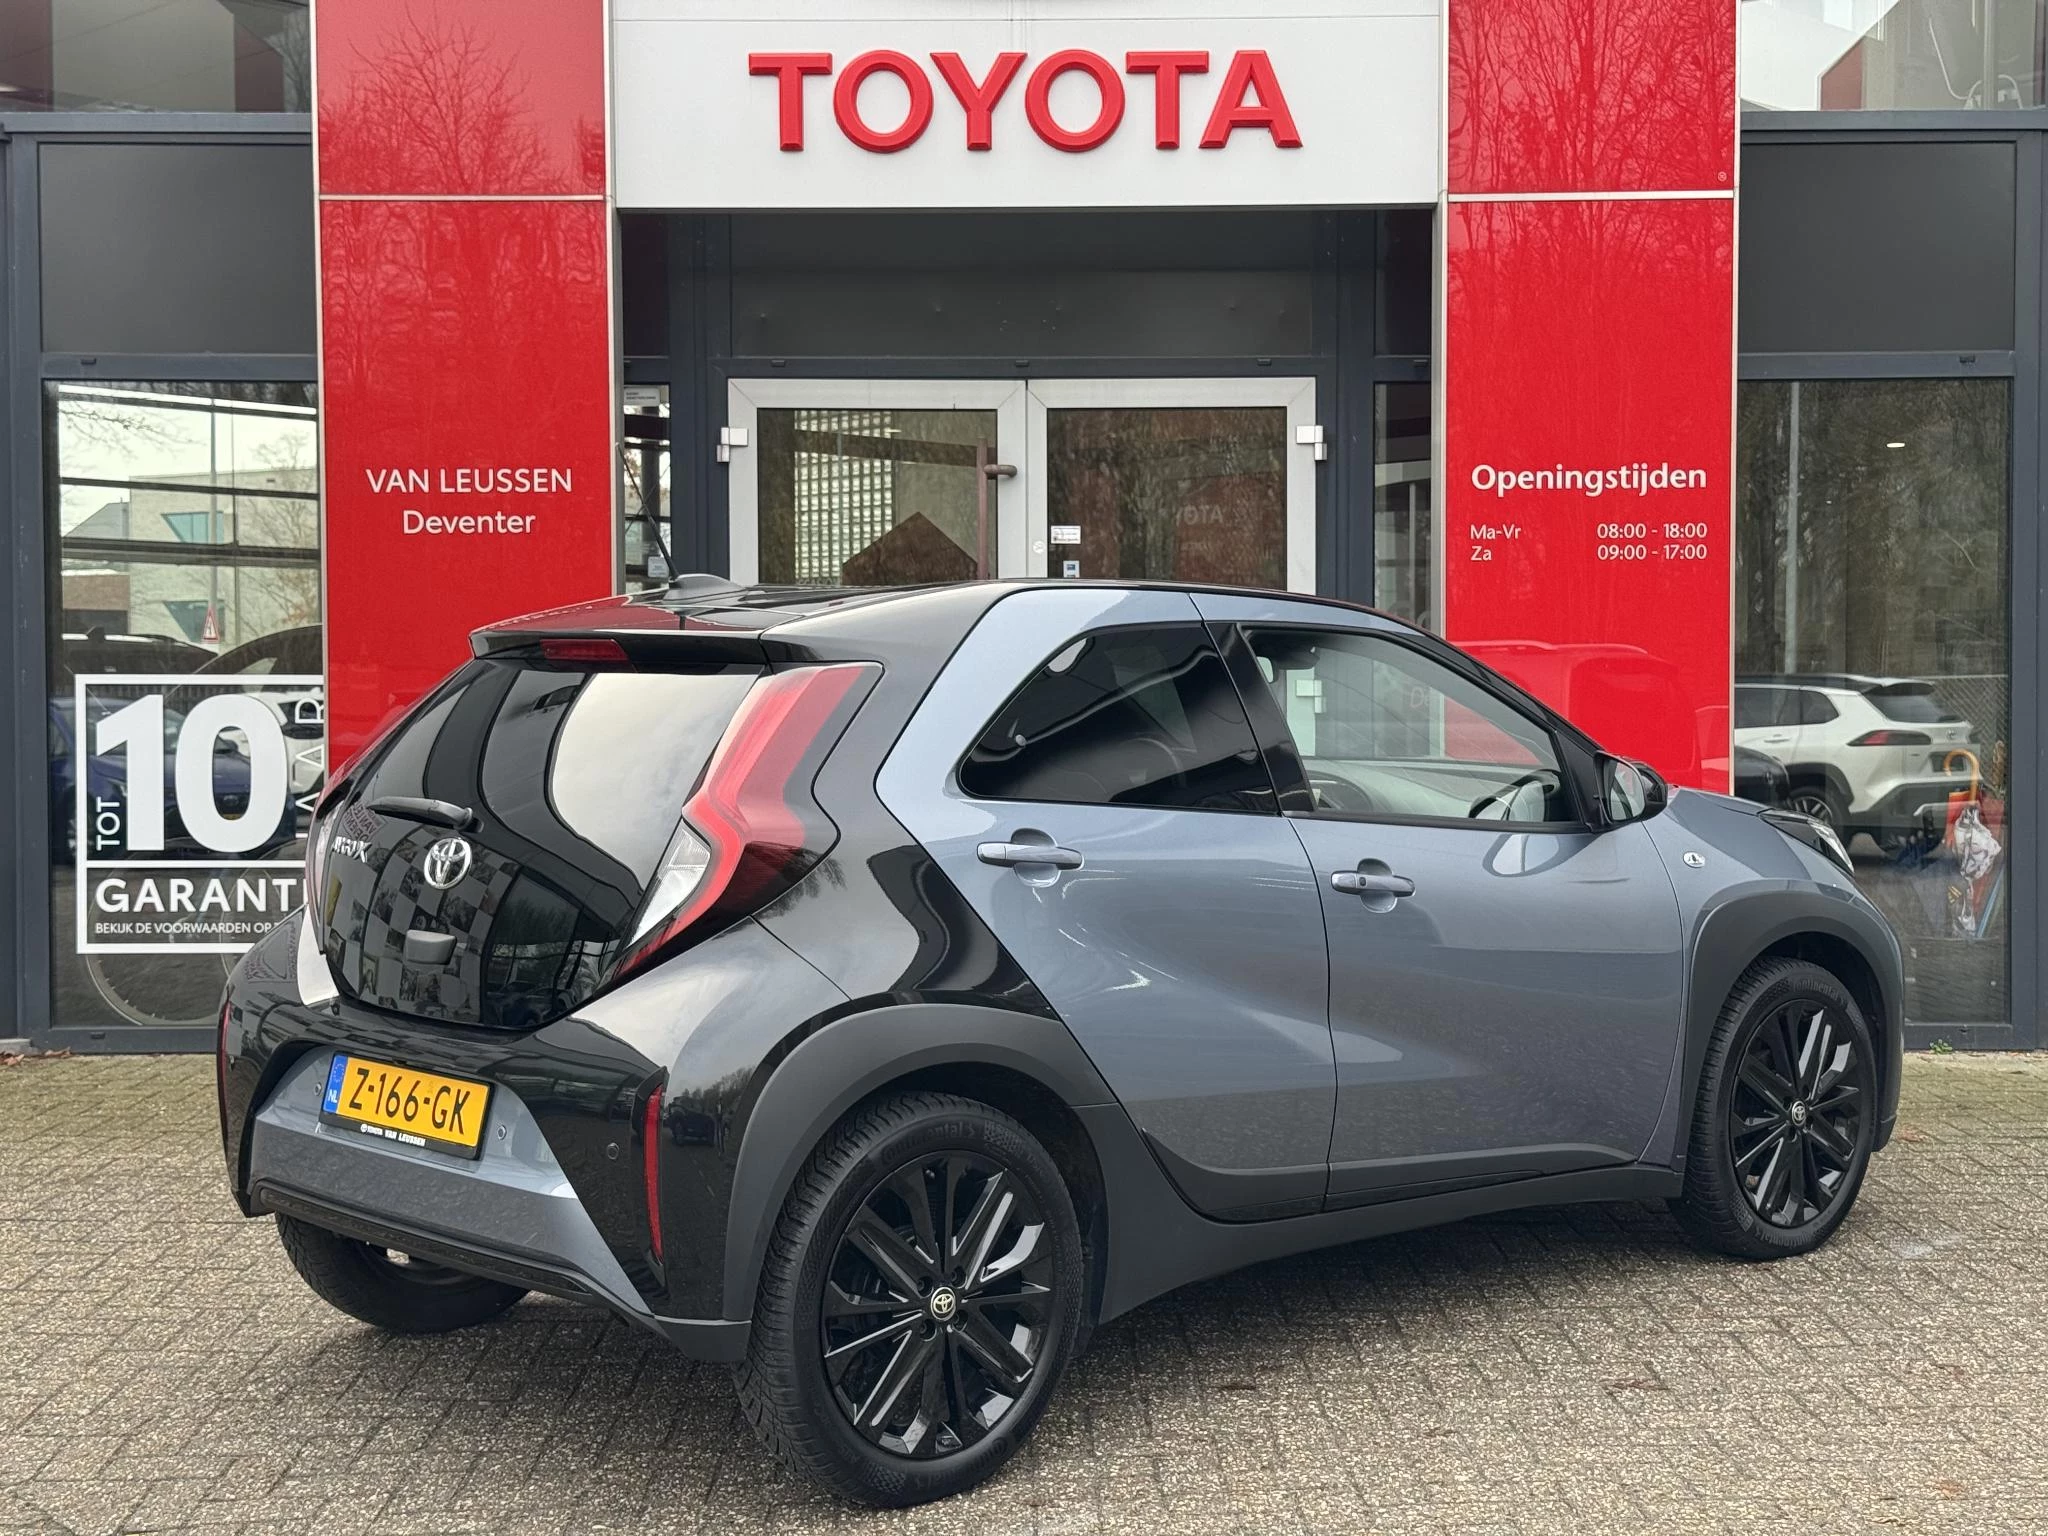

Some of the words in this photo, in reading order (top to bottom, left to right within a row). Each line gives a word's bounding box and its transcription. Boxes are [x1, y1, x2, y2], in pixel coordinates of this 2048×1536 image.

[749, 50, 1303, 153] TOYOTA
[365, 468, 429, 493] VAN
[440, 468, 572, 493] LEUSSEN
[1471, 462, 1707, 498] Openingstijden
[403, 510, 536, 534] Deventer
[1470, 524, 1521, 540] Ma-Vr
[1597, 523, 1646, 539] 08:00
[1663, 523, 1708, 539] 18:00
[1470, 545, 1492, 561] Za
[1597, 544, 1647, 560] 09:00
[1663, 544, 1708, 560] 17:00
[96, 694, 288, 852] 10
[96, 796, 121, 850] TOT
[95, 922, 133, 934] BEKIJK
[136, 922, 152, 934] DE
[154, 922, 251, 934] VOORWAARDEN
[328, 1089, 338, 1104] NL
[349, 1067, 470, 1135] Z-166-GK
